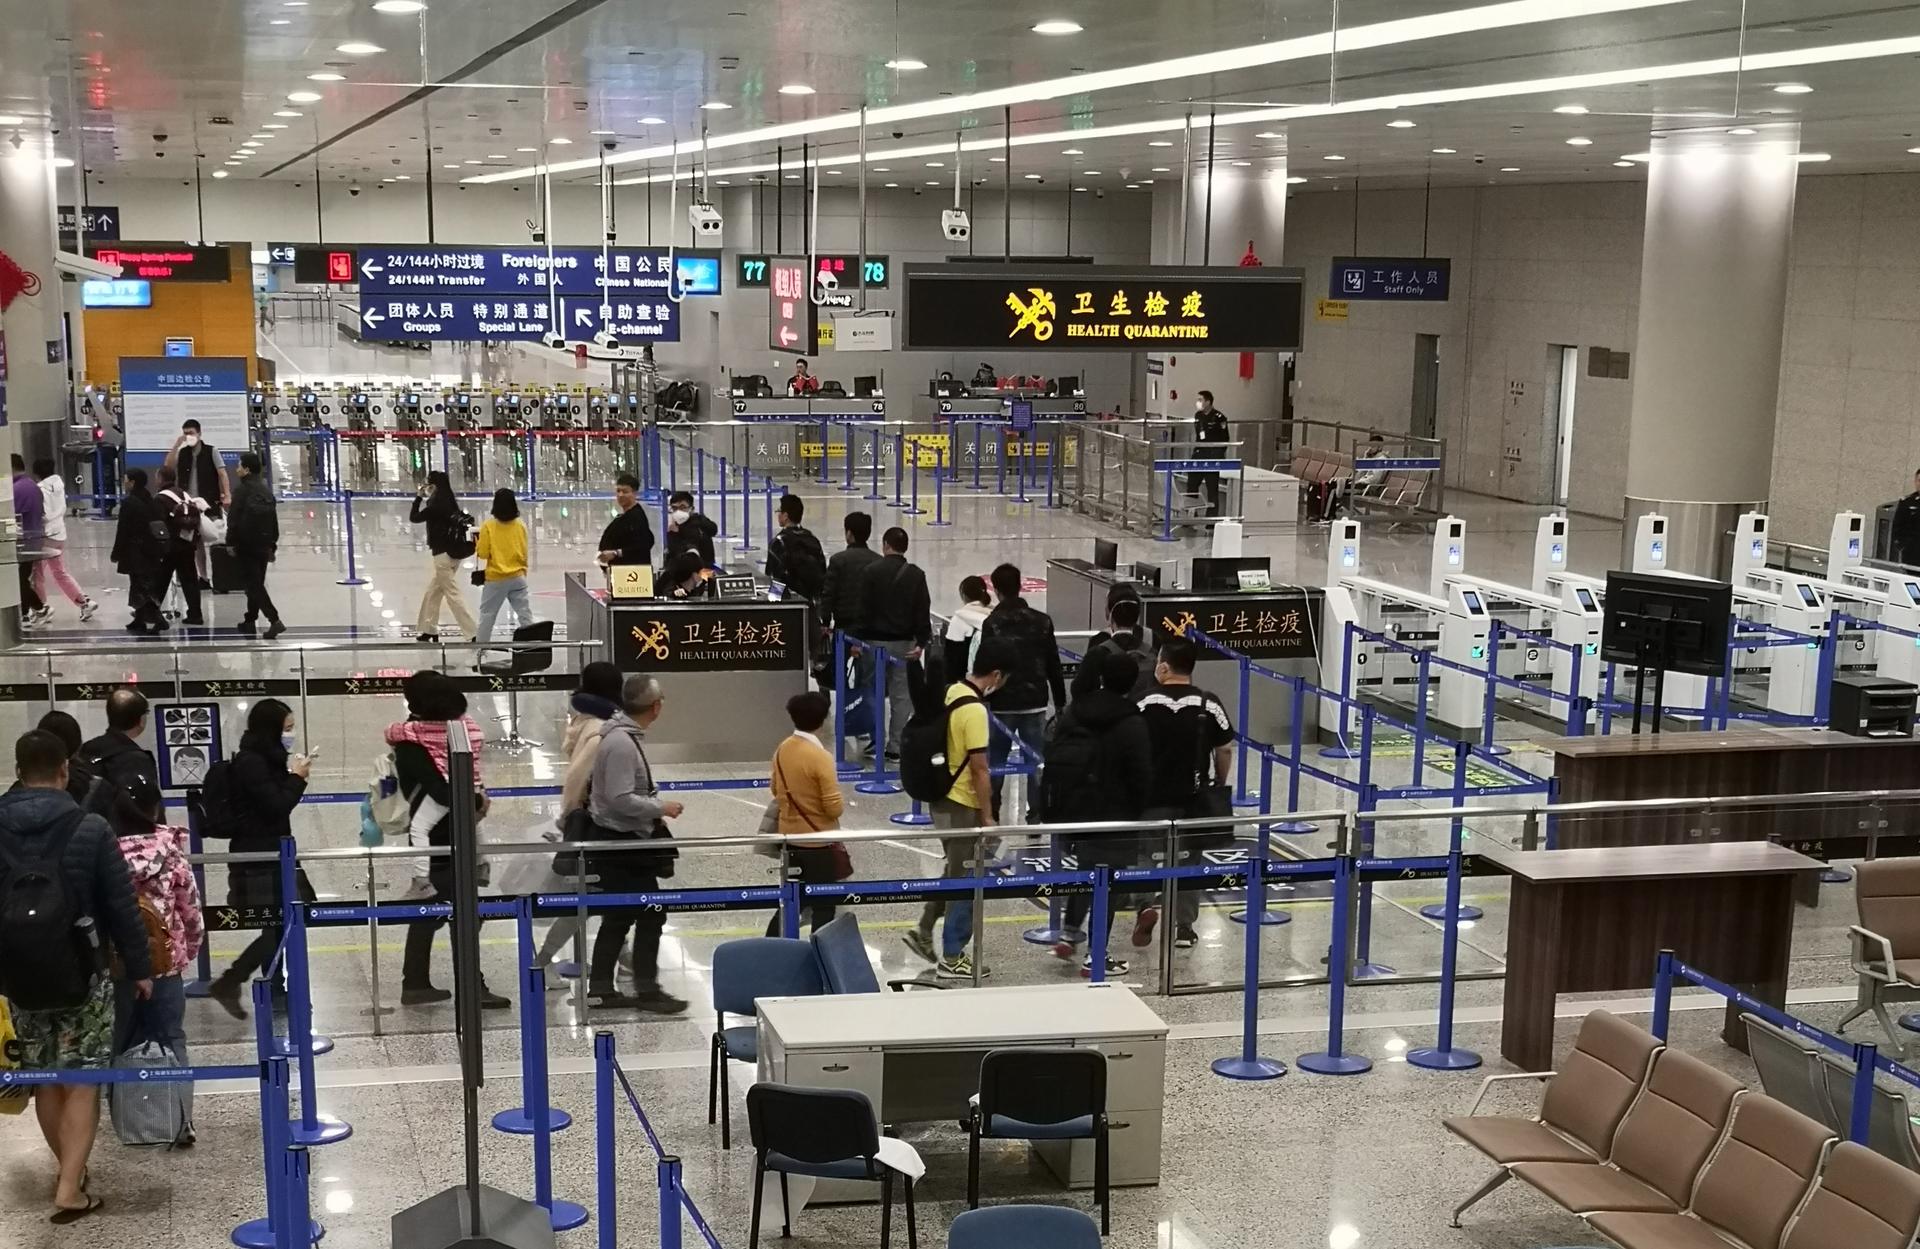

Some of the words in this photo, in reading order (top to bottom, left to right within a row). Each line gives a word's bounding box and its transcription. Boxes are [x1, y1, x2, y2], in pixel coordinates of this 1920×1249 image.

[388, 254, 485, 269] 24/144小时过境
[502, 254, 578, 270] Foreigners
[594, 255, 671, 273] 中国公民
[743, 261, 767, 281] 77
[864, 262, 885, 282] 78
[1371, 270, 1439, 285] 工作人员
[388, 275, 435, 285] 24/144H
[437, 275, 486, 285] Transfer
[517, 273, 563, 286] 外国人
[1383, 285, 1404, 294] Staff
[1405, 286, 1424, 295] Only
[388, 303, 455, 318] 团体人员
[1071, 290, 1206, 318] 卫生检疫
[473, 303, 549, 320] 特别通道
[599, 304, 671, 321] 自助查验
[403, 322, 442, 334] Groups
[479, 322, 515, 335] Special
[518, 322, 544, 333] Lane
[1067, 324, 1120, 337] HEALTH
[1123, 325, 1209, 339] QUARANTINE
[735, 402, 746, 410] 77
[873, 402, 883, 410] 78
[942, 402, 951, 410] 79
[1074, 402, 1084, 410] 80
[757, 442, 790, 455] 关闭
[862, 442, 894, 455] 关闭
[965, 442, 997, 455] 关闭
[1206, 610, 1303, 634] 卫生检疫
[680, 620, 786, 646] 卫生检疫
[1243, 637, 1302, 649] QUARANTINE
[680, 650, 719, 660] HEALTH
[721, 650, 786, 661] QUARANTINE
